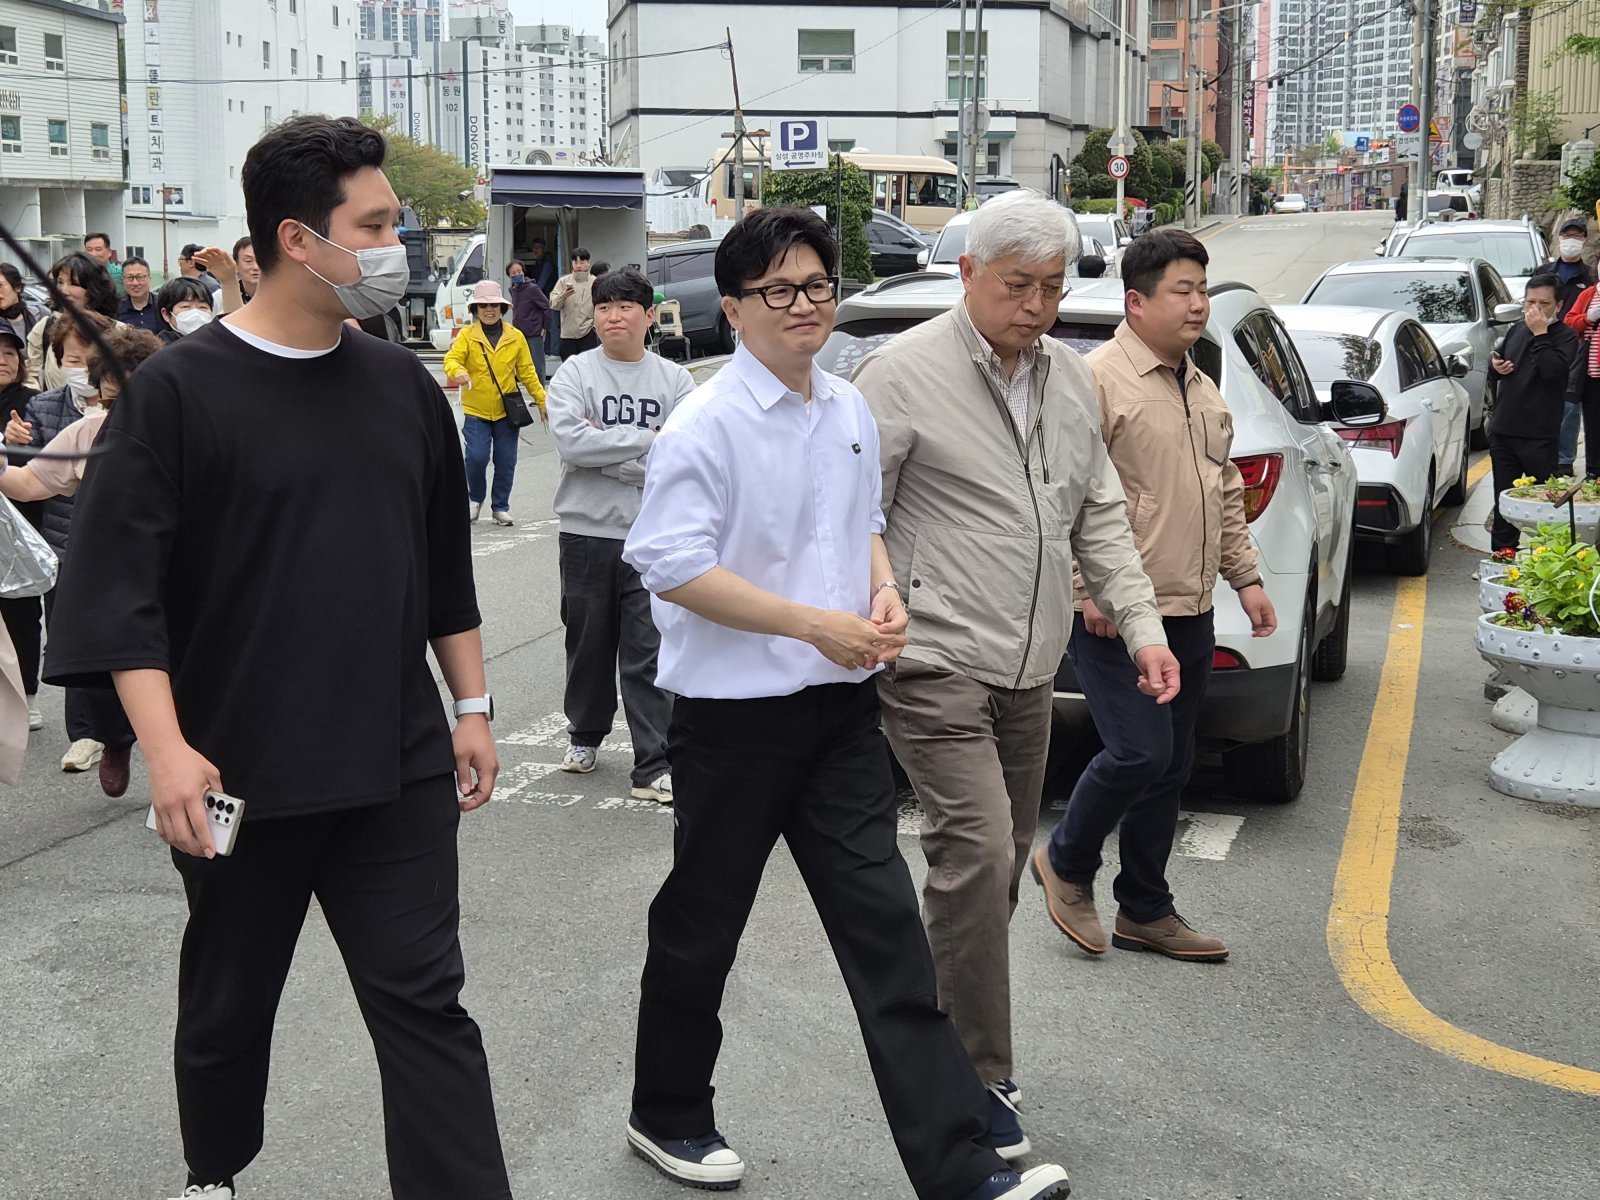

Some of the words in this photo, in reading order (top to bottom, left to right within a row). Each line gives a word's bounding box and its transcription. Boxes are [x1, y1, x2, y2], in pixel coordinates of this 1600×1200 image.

[498, 20, 506, 35] 동
[443, 86, 461, 97] 동원
[445, 103, 459, 112] 102
[788, 123, 809, 150] P
[1113, 162, 1125, 173] 30
